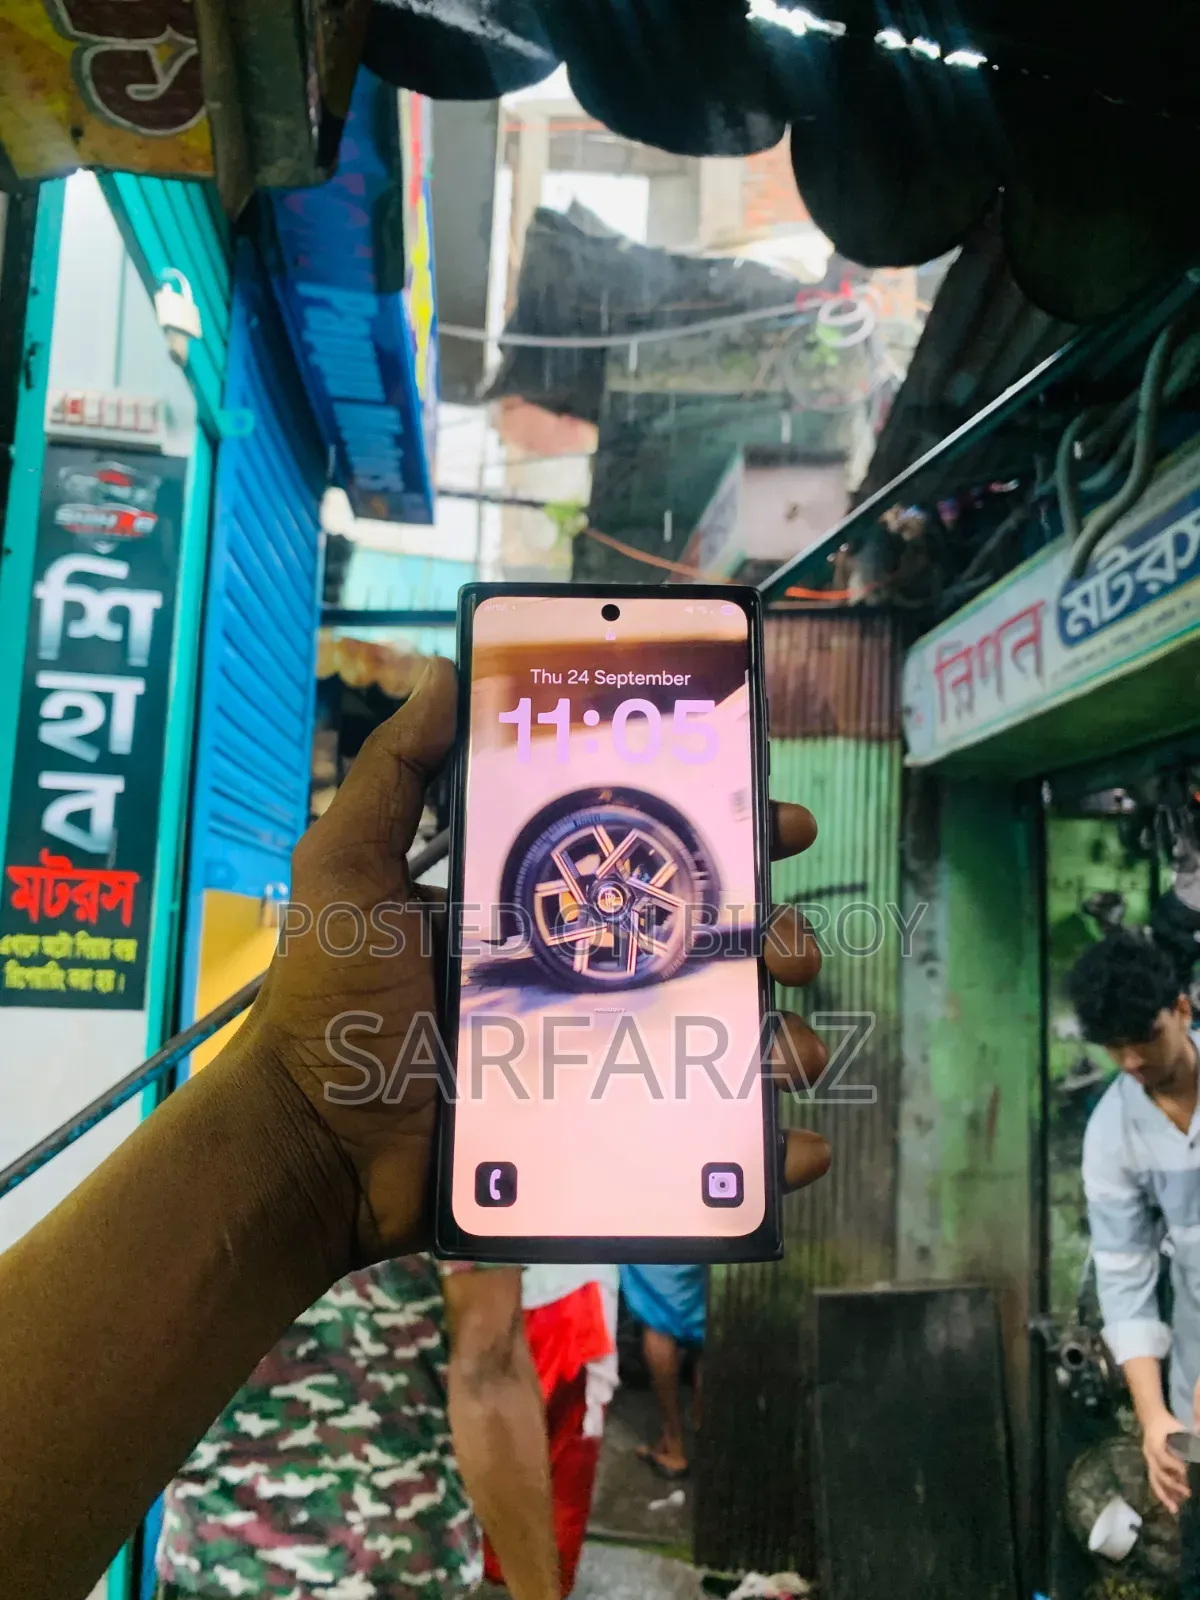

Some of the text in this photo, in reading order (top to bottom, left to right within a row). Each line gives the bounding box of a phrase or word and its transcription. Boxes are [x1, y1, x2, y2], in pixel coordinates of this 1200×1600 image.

[530, 668, 692, 689] Thu 24 September
[498, 697, 720, 765] 11:05
